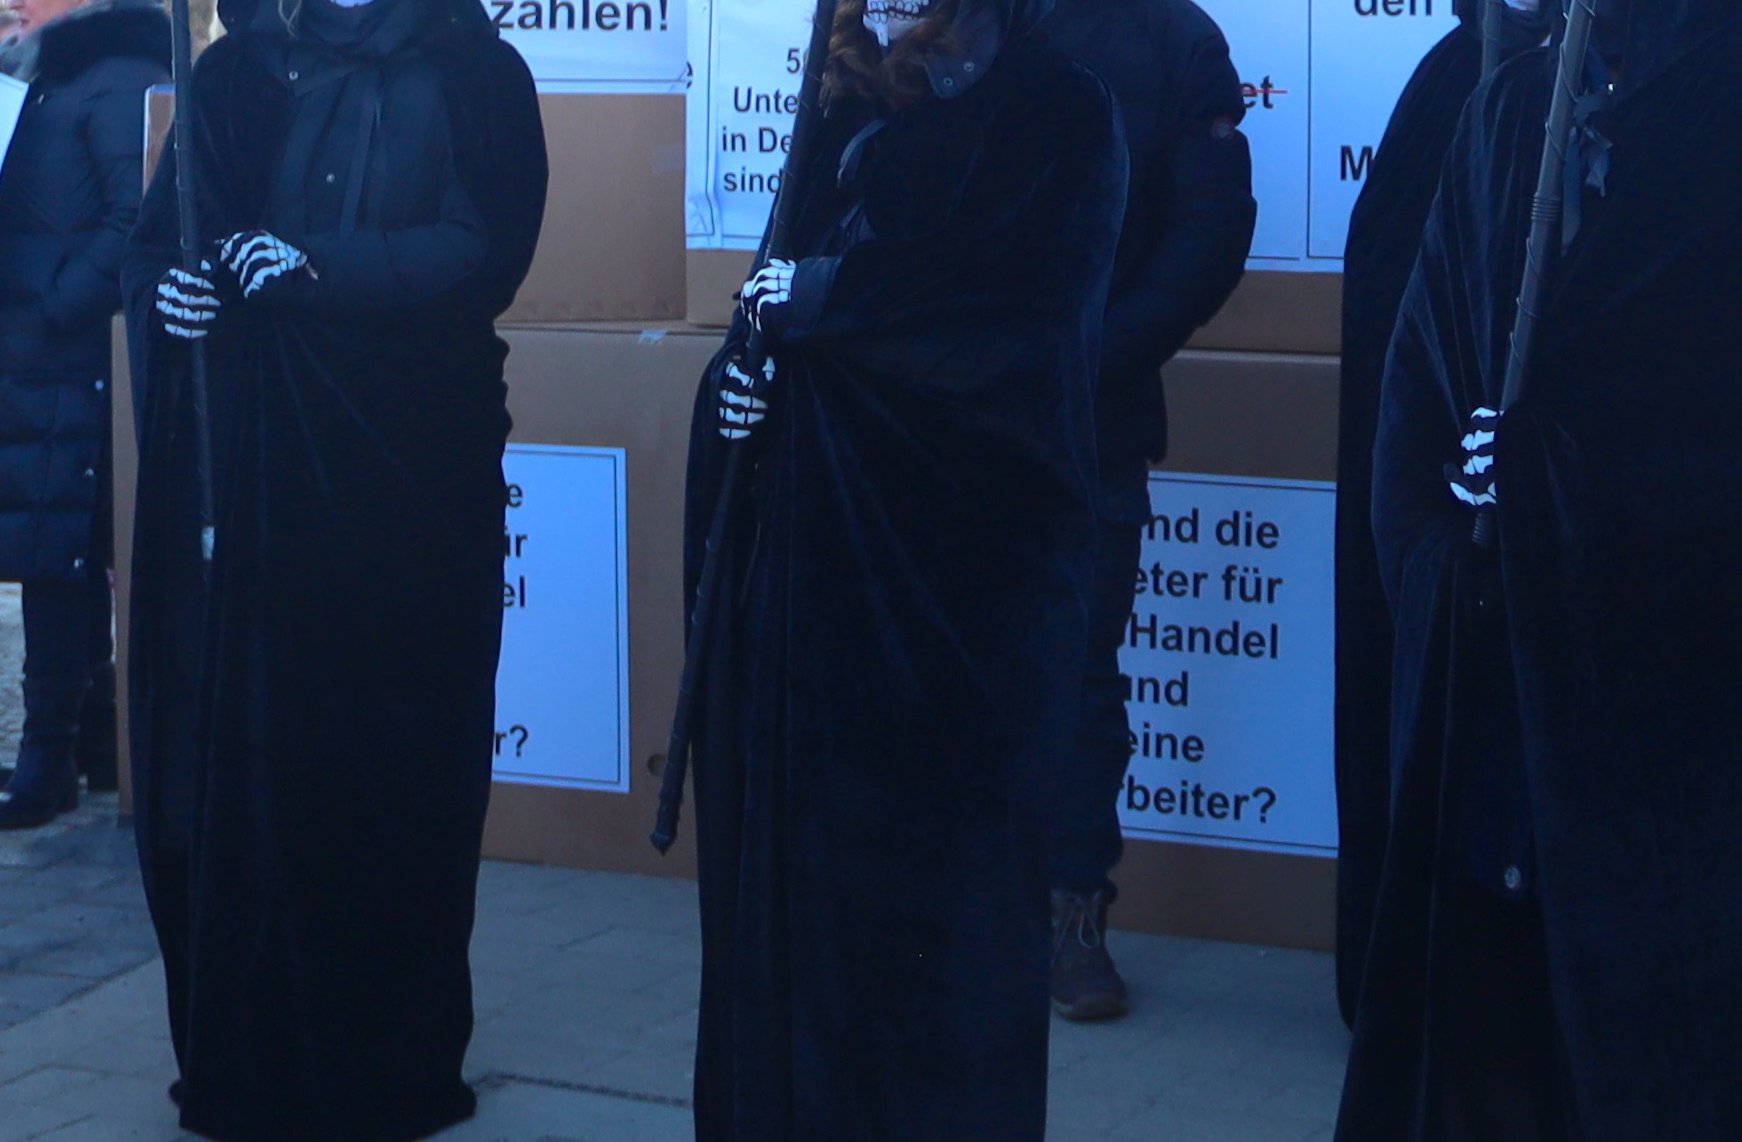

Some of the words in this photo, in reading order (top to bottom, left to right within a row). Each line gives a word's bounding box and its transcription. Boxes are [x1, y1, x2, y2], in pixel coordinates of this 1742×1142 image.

[722, 127, 747, 152] in
[1215, 510, 1280, 549] die
[1222, 564, 1284, 604] für
[1130, 613, 1279, 659] Handel
[1122, 775, 1277, 823] beiter?
